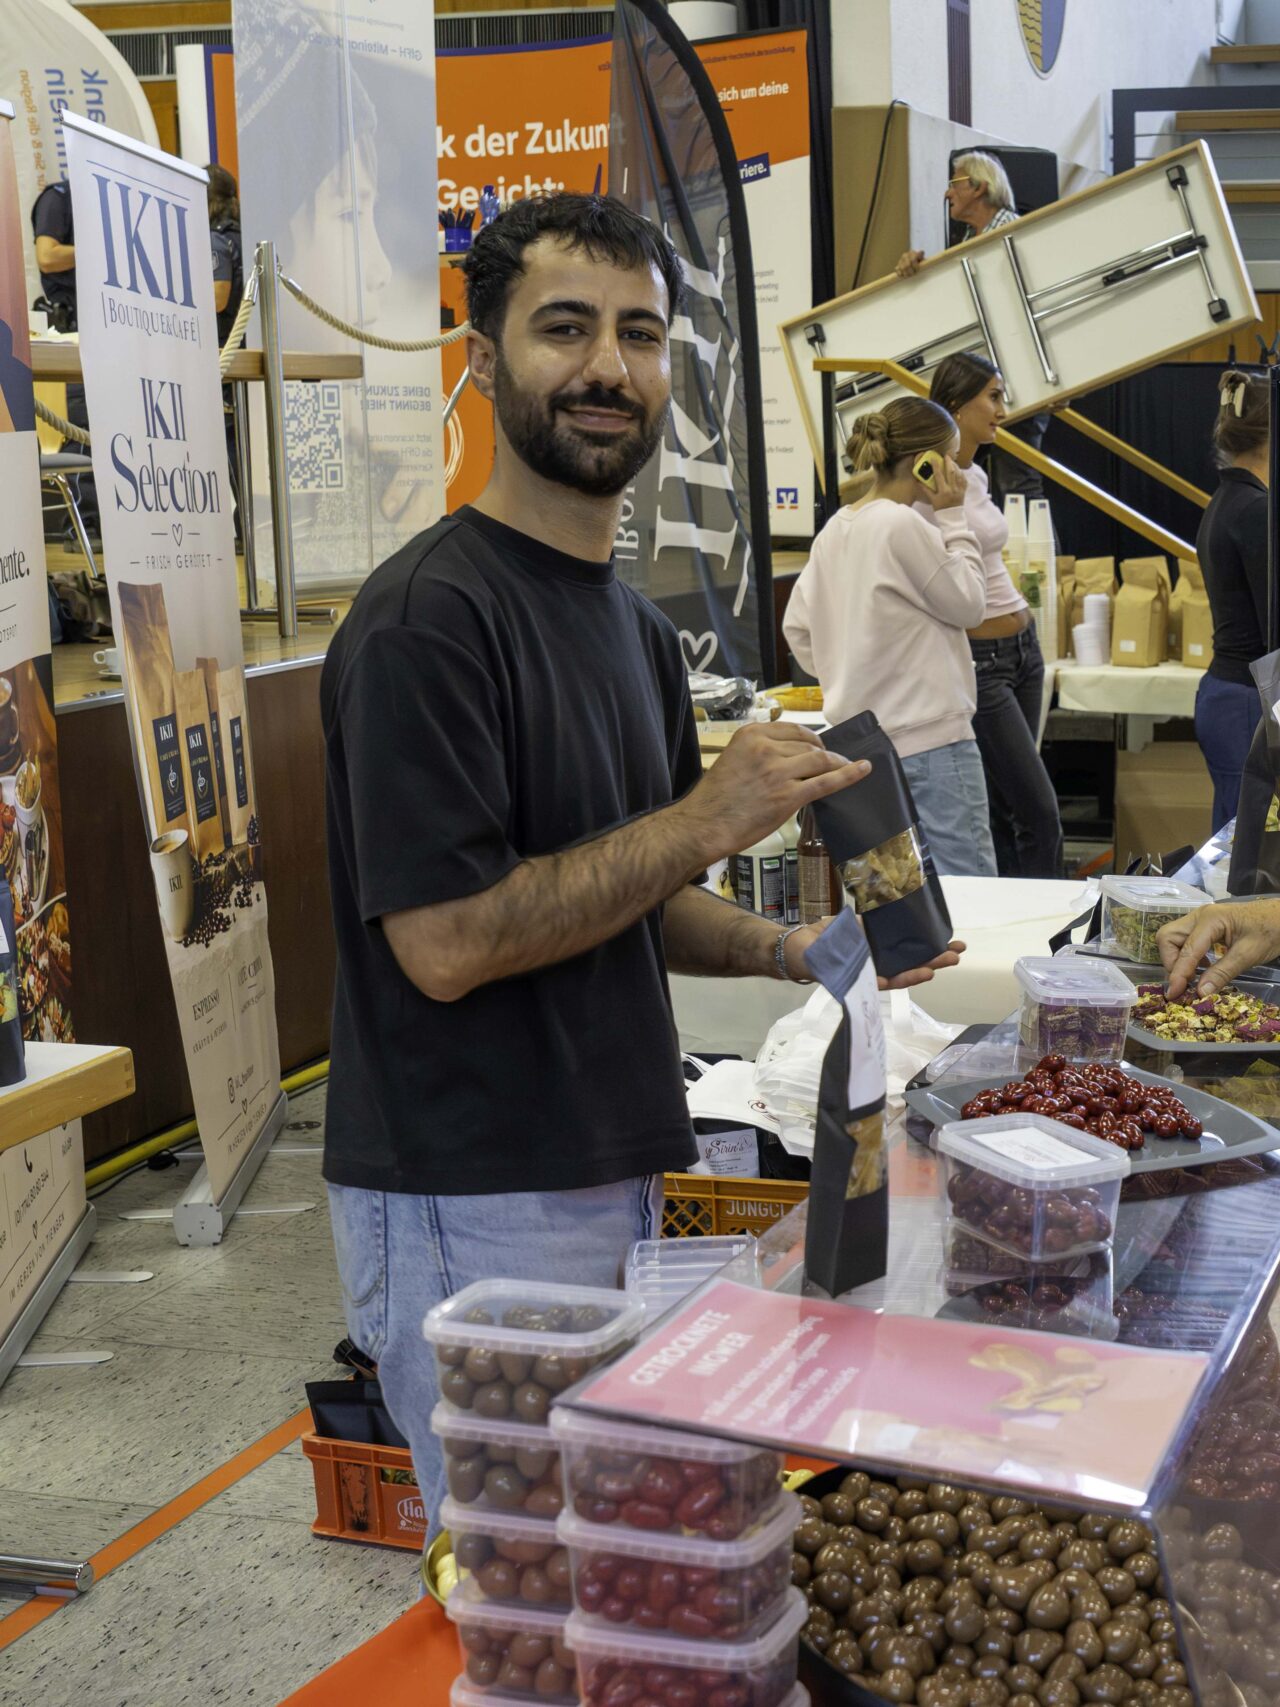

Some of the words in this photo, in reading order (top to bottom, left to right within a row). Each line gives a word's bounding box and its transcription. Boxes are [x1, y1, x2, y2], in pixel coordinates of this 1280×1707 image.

[740, 87, 758, 99] um
[758, 80, 790, 97] deine
[464, 123, 519, 158] der
[91, 173, 198, 309] IKII
[139, 376, 188, 442] IKII
[110, 432, 222, 514] Selection
[191, 988, 221, 1022] ESPRESSO
[628, 1308, 732, 1386] GETROCKNETE
[688, 1331, 755, 1377] INGWER
